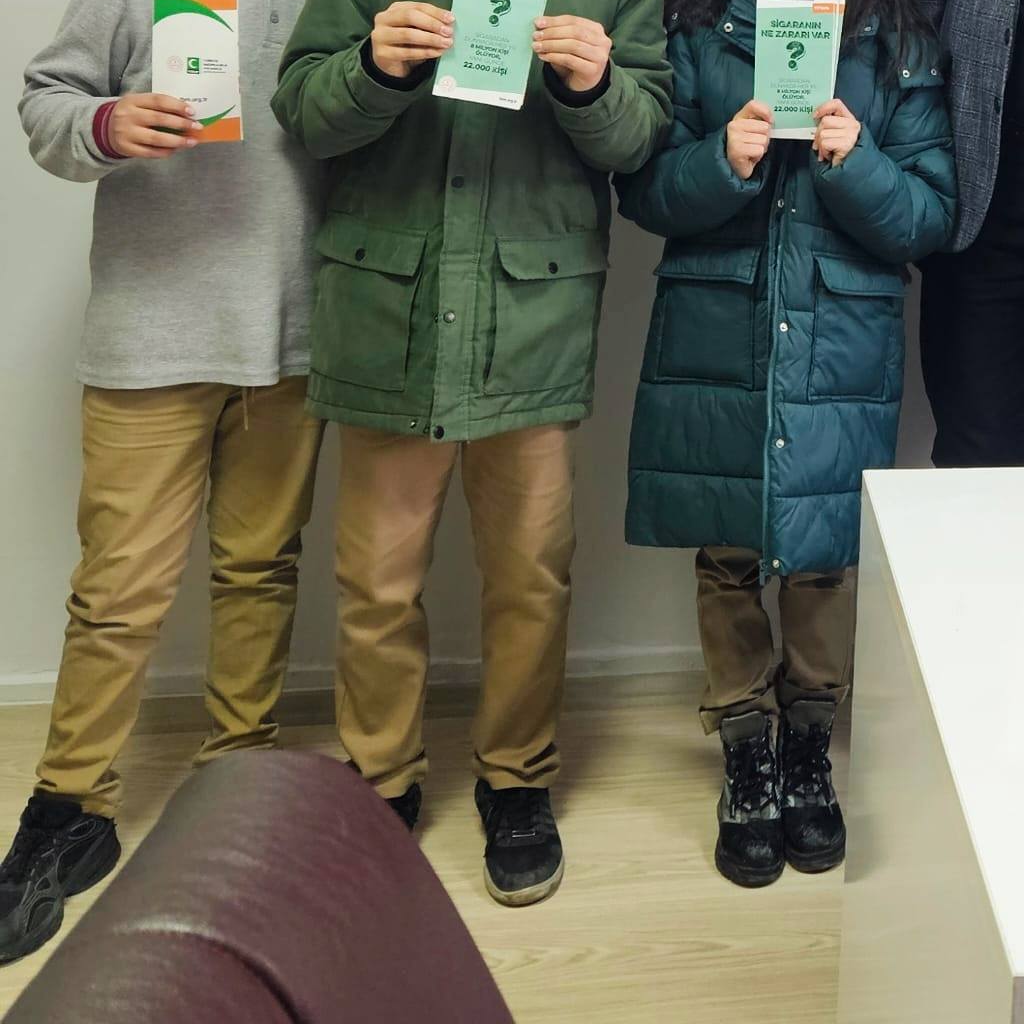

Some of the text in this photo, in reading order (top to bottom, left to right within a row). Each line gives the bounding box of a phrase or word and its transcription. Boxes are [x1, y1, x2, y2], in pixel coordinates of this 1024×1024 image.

[770, 19, 822, 29] SİGARANIN
[775, 31, 810, 39] ZARARI
[811, 31, 831, 39] VAR
[463, 61, 491, 72] 22.000
[773, 105, 798, 113] 22.000
